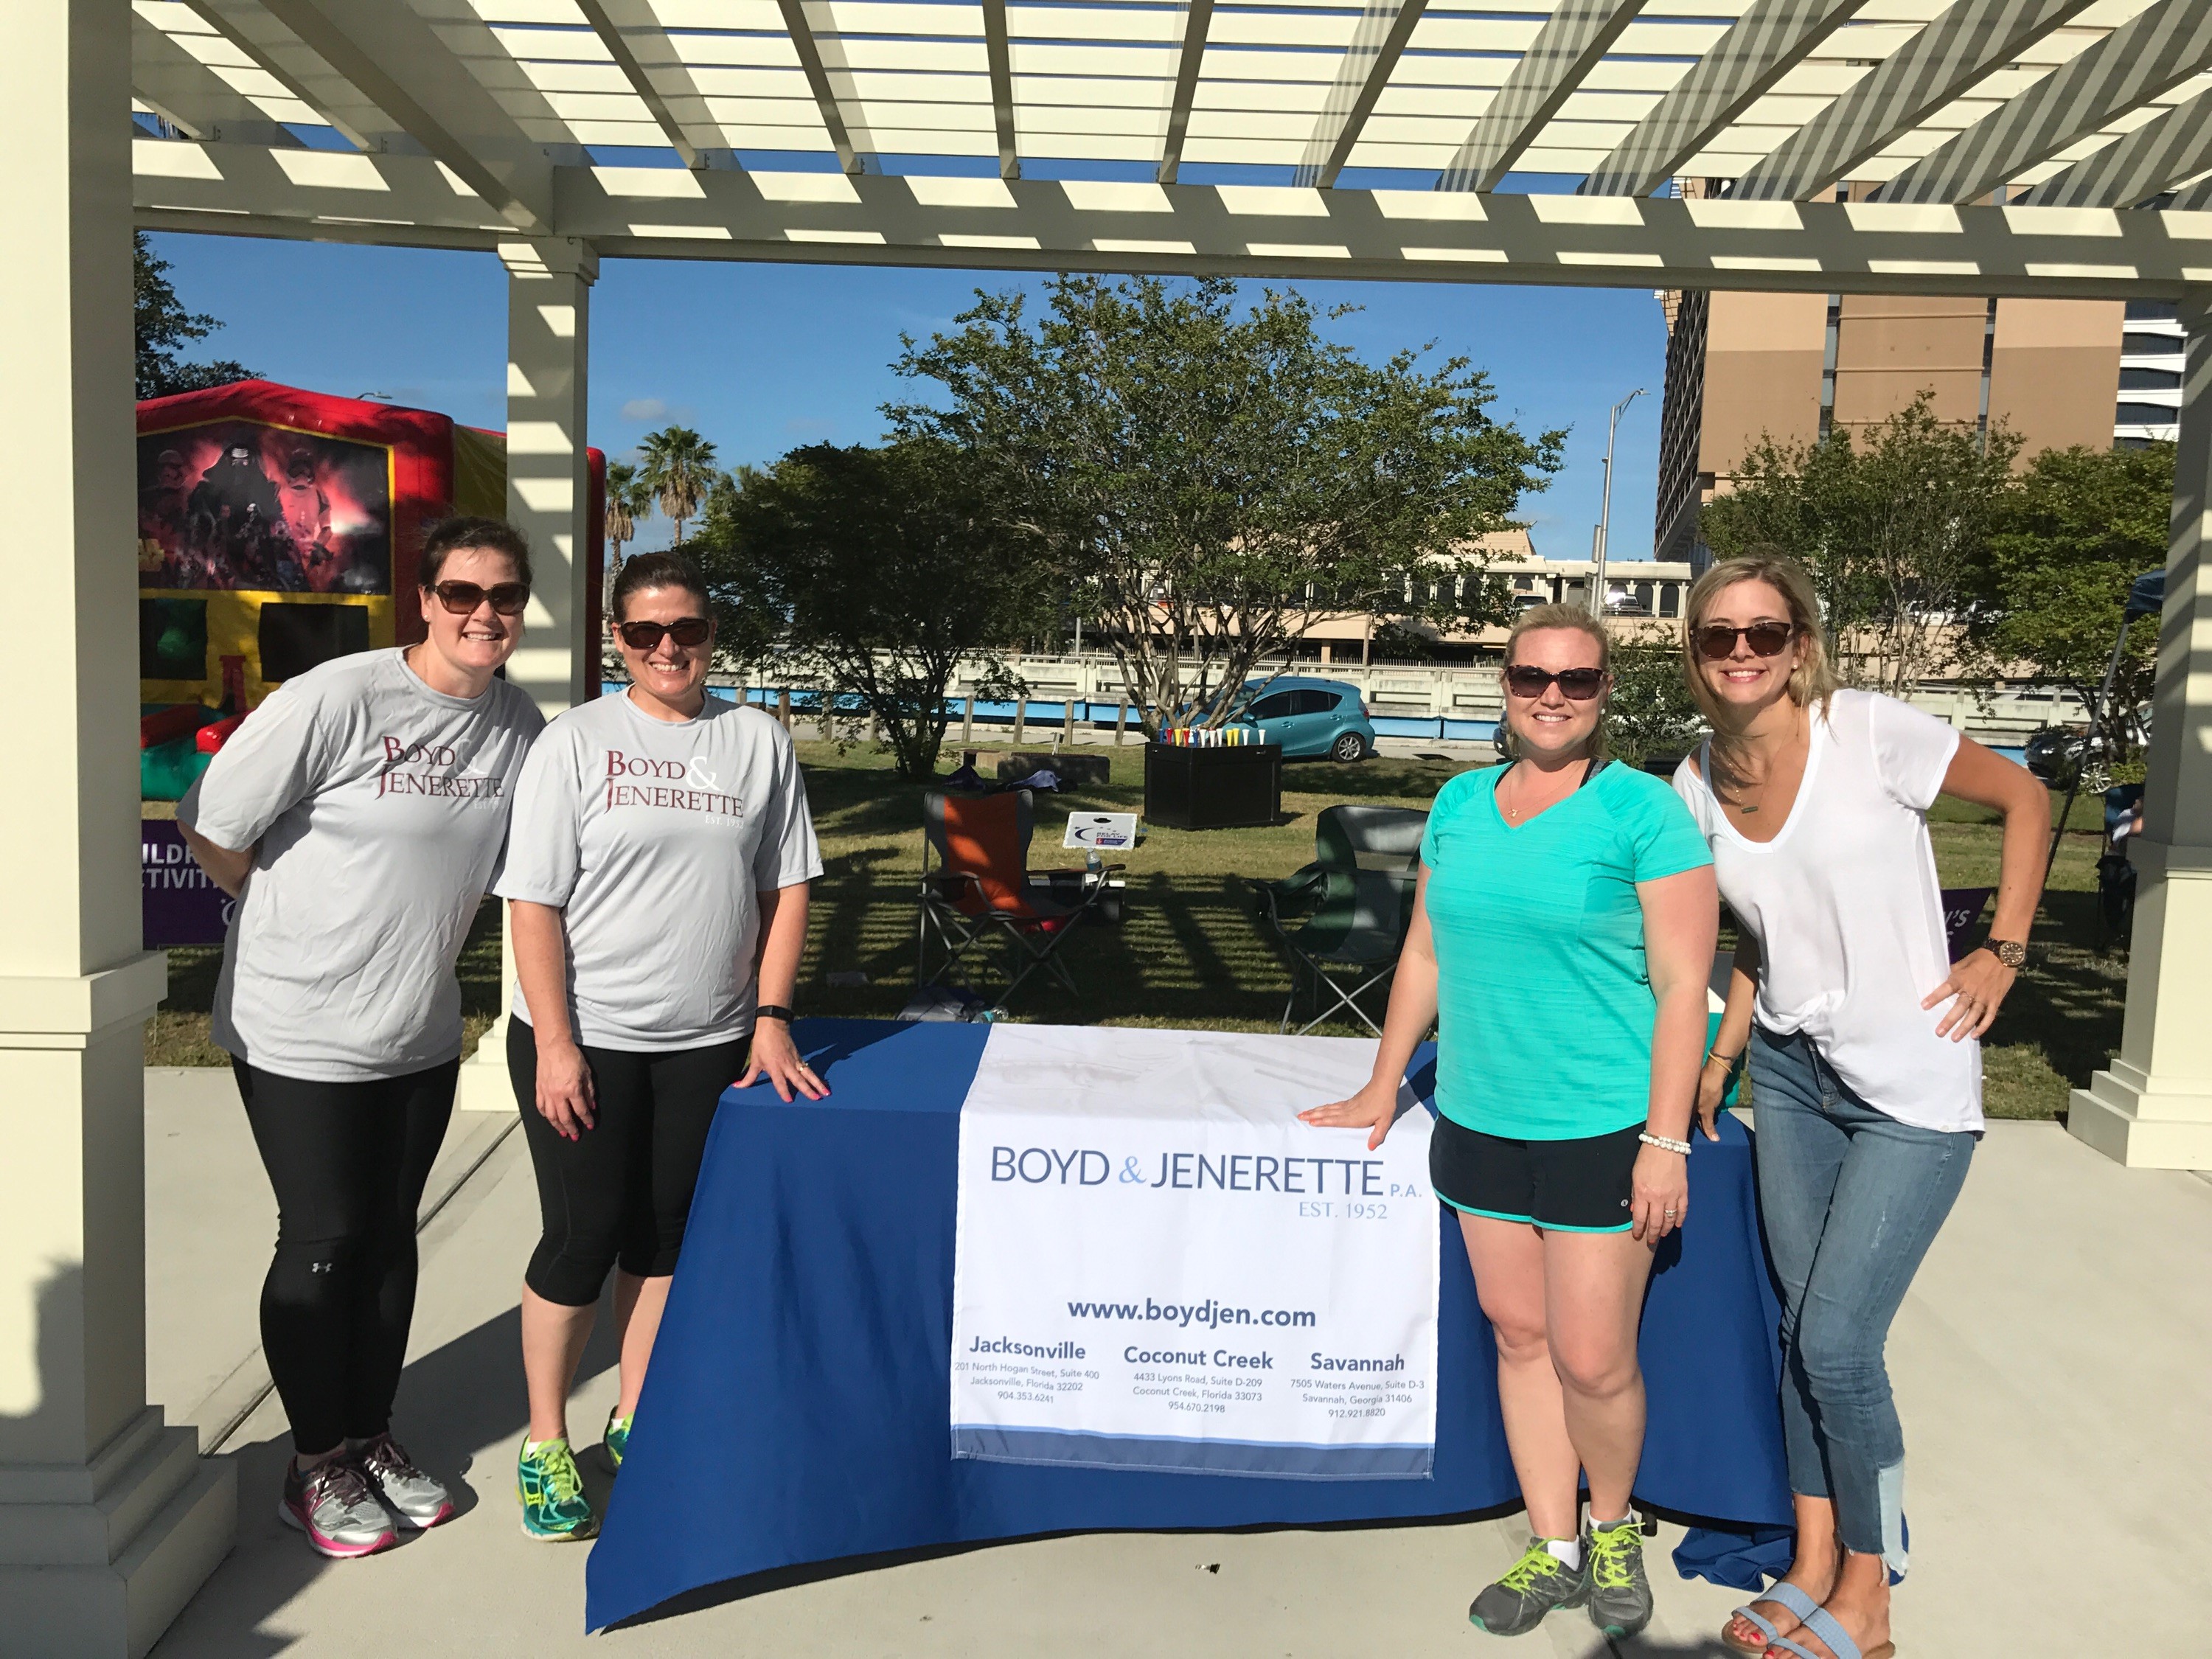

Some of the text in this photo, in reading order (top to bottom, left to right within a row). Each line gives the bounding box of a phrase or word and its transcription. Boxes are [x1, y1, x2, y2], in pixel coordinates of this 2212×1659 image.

[382, 736, 489, 776] BOYD &
[605, 750, 724, 792] BOYD &
[375, 764, 505, 800] JENERETTE
[604, 778, 744, 818] JENERETTE
[726, 818, 744, 830] 1952
[992, 1147, 1422, 1197] BOYD & JENERETTE P.A.
[1299, 1202, 1388, 1220] EST. 1952
[1068, 1298, 1315, 1329] www.boydjen.com
[969, 1336, 1086, 1359] Jacksonville
[1124, 1346, 1273, 1369] Coconut Creek
[1310, 1352, 1405, 1371] Savannah
[955, 1363, 1099, 1380] 201 North Hogan Street, Suite 400
[1133, 1372, 1262, 1387] 4433 Lyons Road, Suite D-209
[970, 1376, 1083, 1391] Jacksonville, Florida 32202
[1290, 1379, 1425, 1391] 7505 Waters Avenue, Suite D-3
[998, 1391, 1054, 1403] 904.353.6241
[1133, 1386, 1262, 1401] Coconut Creek, Florida 33073
[1302, 1393, 1412, 1405] Savannah, Georgia 31406
[1168, 1401, 1225, 1413] 954.670.2198
[1328, 1408, 1385, 1418] 912.921.8820
